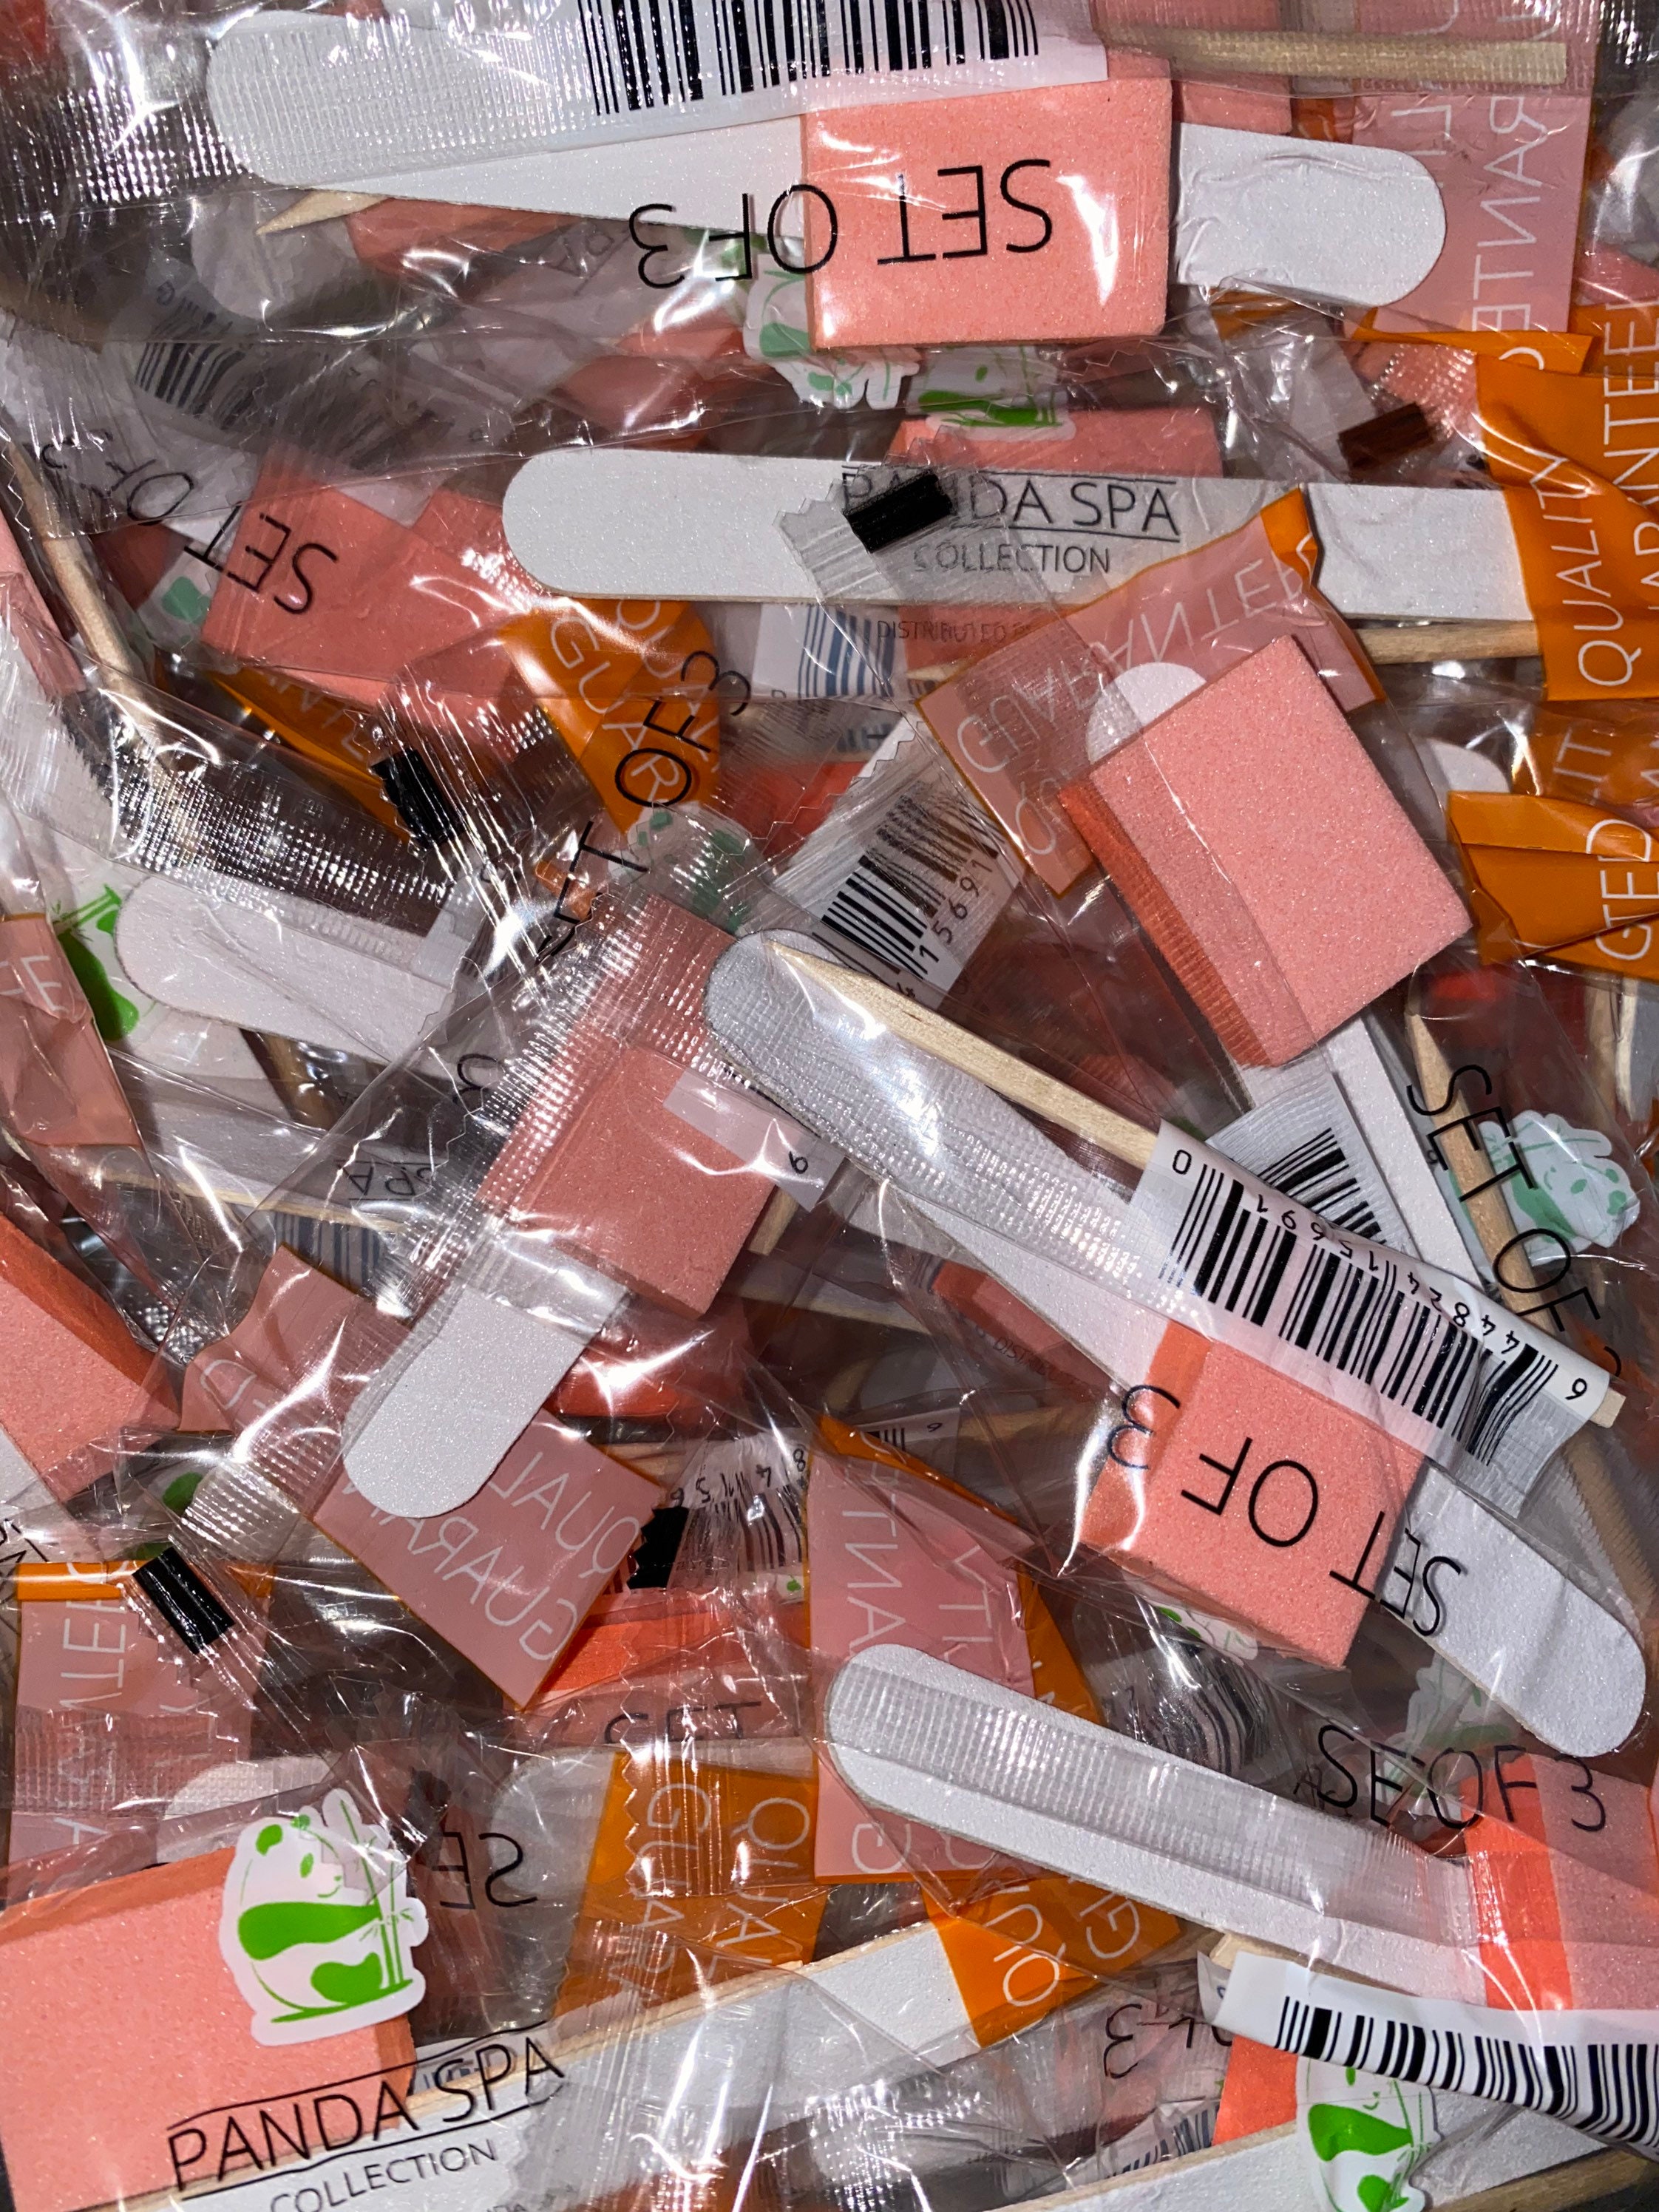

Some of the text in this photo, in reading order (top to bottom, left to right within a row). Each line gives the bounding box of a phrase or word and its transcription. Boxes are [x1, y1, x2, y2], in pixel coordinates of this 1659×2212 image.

[628, 204, 685, 289] 3
[710, 184, 838, 281] OF
[878, 160, 1053, 266] SET
[185, 501, 339, 614] SET
[912, 541, 1110, 575] COLLECTION
[1071, 481, 1181, 537] SPA
[615, 699, 712, 808] OF
[680, 650, 752, 717] 3
[1407, 1065, 1602, 1331] SET OF
[1108, 1384, 1462, 1637] SET OF 3
[431, 1831, 540, 1910] SE
[167, 2035, 565, 2191] PANDA SPA
